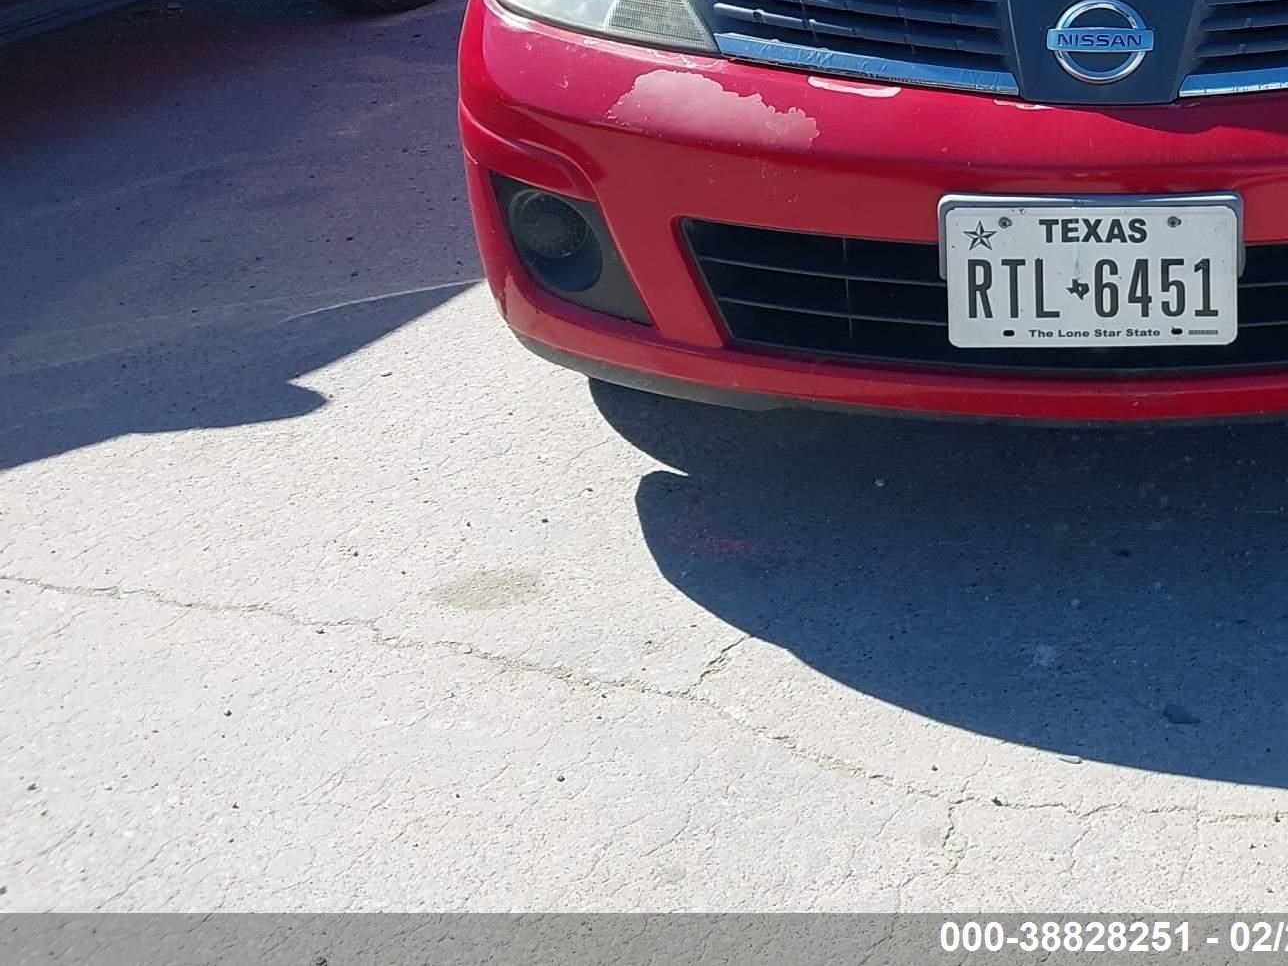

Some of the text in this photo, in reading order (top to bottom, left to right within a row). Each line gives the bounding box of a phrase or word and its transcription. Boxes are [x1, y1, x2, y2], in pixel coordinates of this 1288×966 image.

[1057, 33, 1142, 47] NISSAN
[1039, 218, 1148, 243] TEXAS
[967, 257, 1220, 319] RTL 6451
[1028, 328, 1161, 338] The Lone Star State
